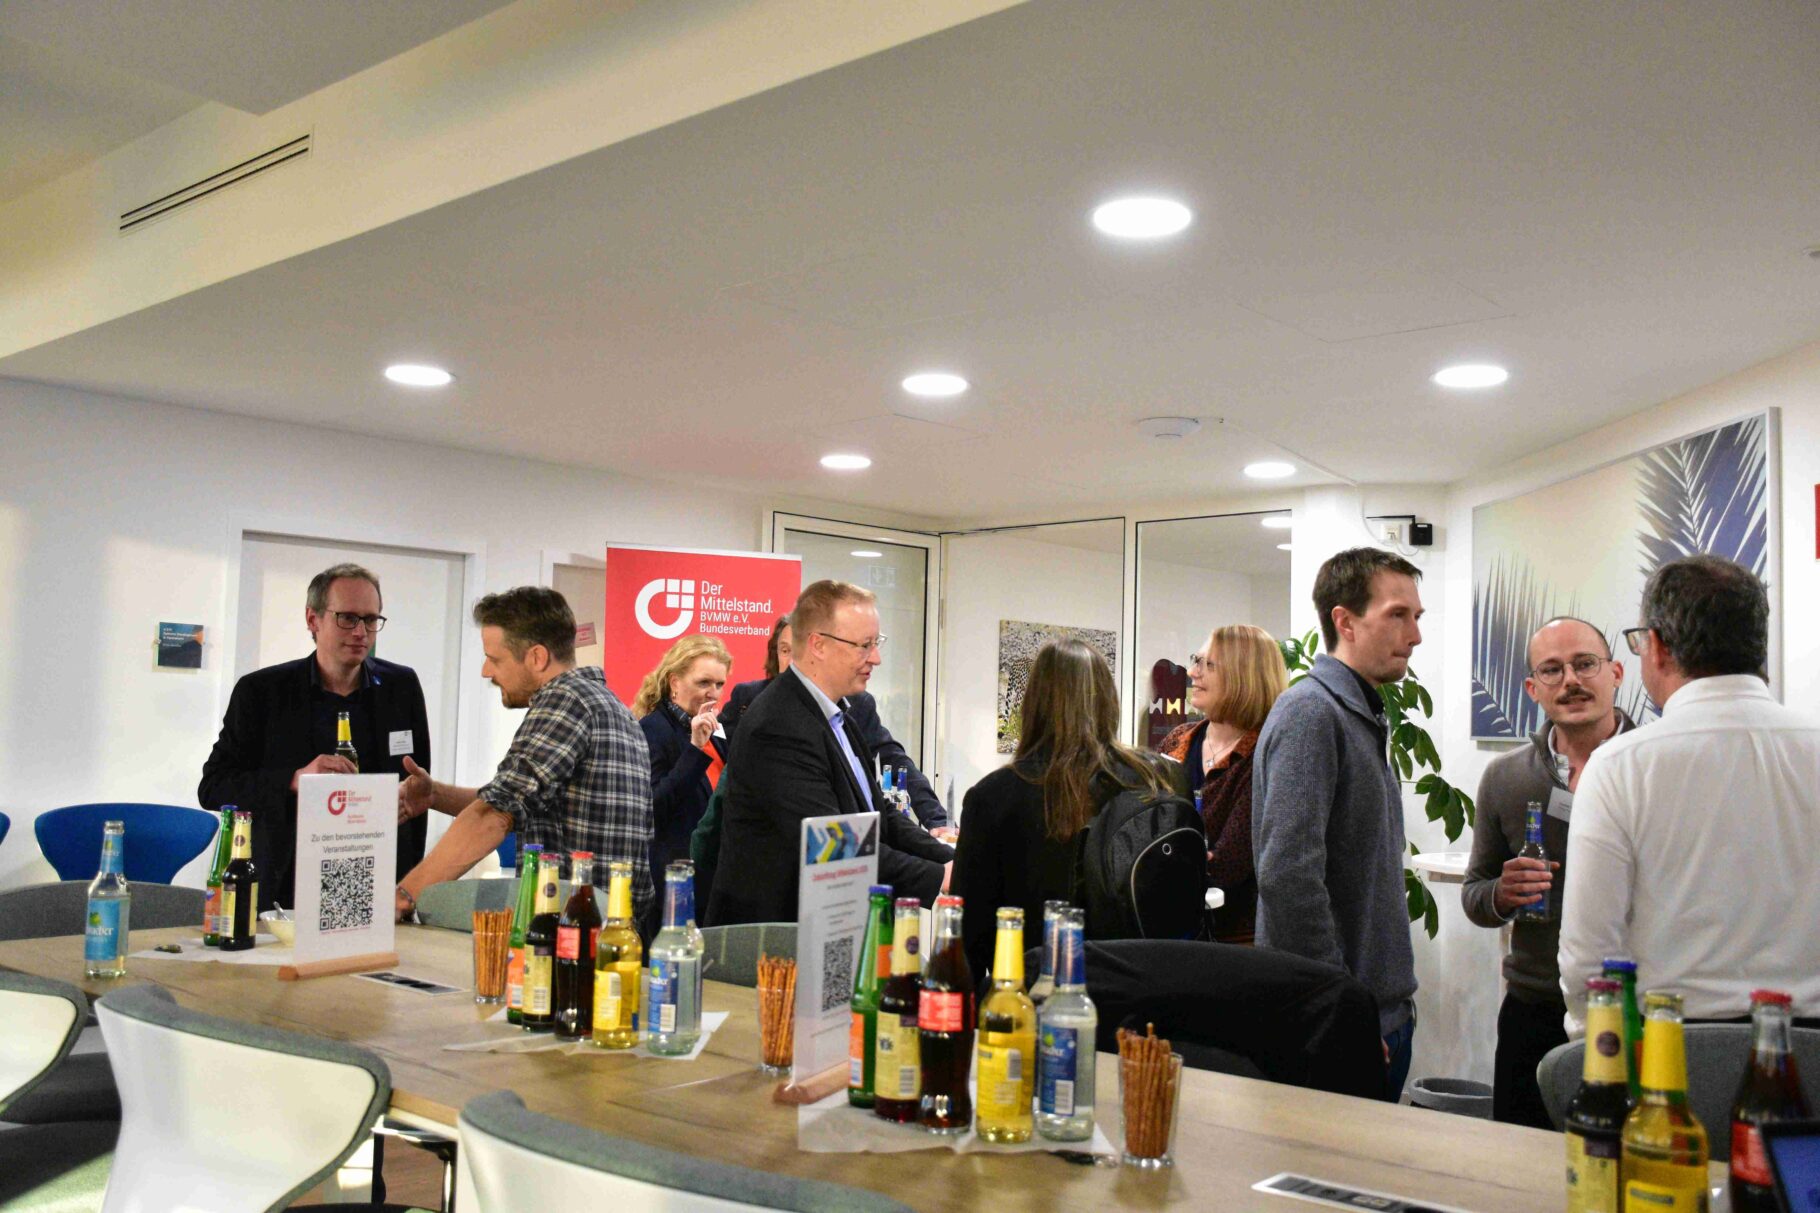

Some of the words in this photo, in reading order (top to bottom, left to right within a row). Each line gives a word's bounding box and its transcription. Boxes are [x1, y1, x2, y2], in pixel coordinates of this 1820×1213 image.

[701, 581, 723, 595] Der
[700, 597, 773, 614] Mittelstand.
[700, 612, 731, 622] BVMW
[733, 614, 750, 624] e.V.
[700, 623, 770, 636] Bundesverband
[311, 834, 321, 842] Zu
[322, 833, 334, 842] den
[335, 831, 385, 842] bevorstehenden
[323, 844, 373, 854] Veranstaltungen
